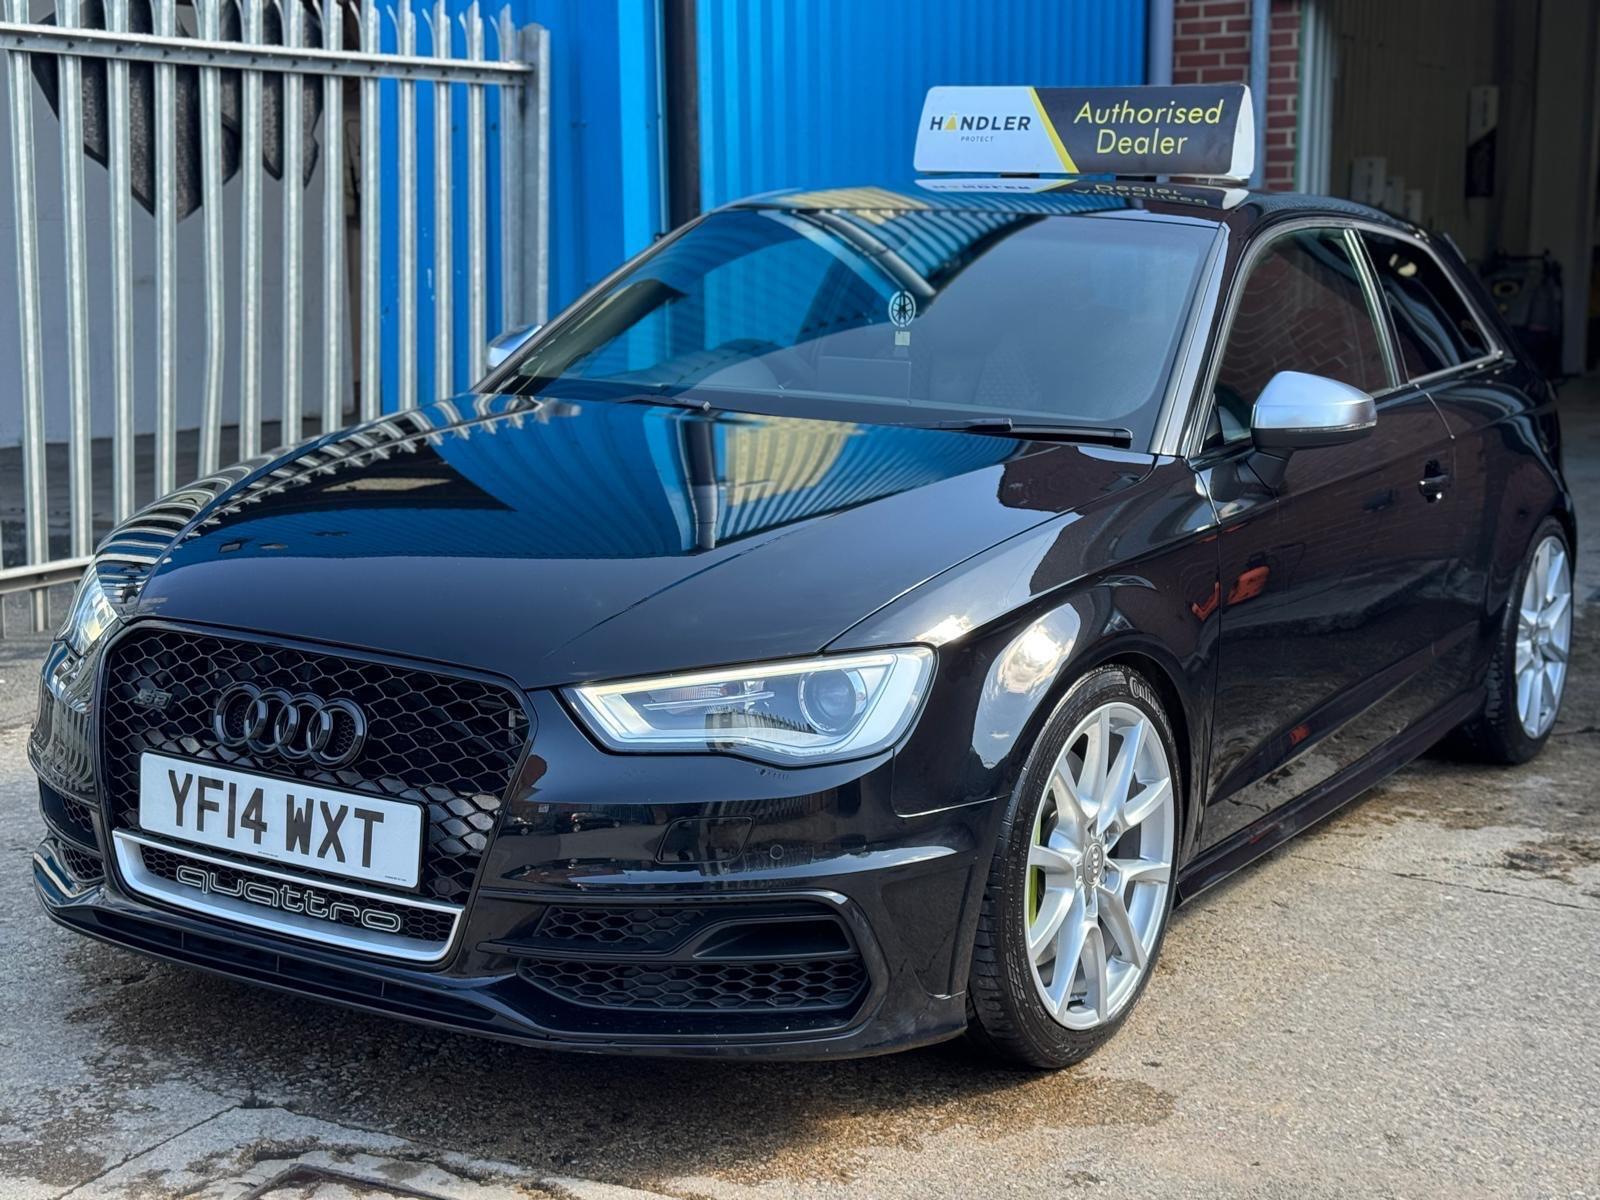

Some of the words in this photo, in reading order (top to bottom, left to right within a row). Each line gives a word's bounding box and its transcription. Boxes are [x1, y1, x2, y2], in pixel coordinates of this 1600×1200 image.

[1073, 99, 1224, 125] Authorised
[960, 135, 994, 143] PROTECT
[1095, 127, 1188, 155] Dealer
[168, 769, 268, 845] YF14
[286, 794, 384, 869] WXT
[176, 864, 402, 934] quattro
